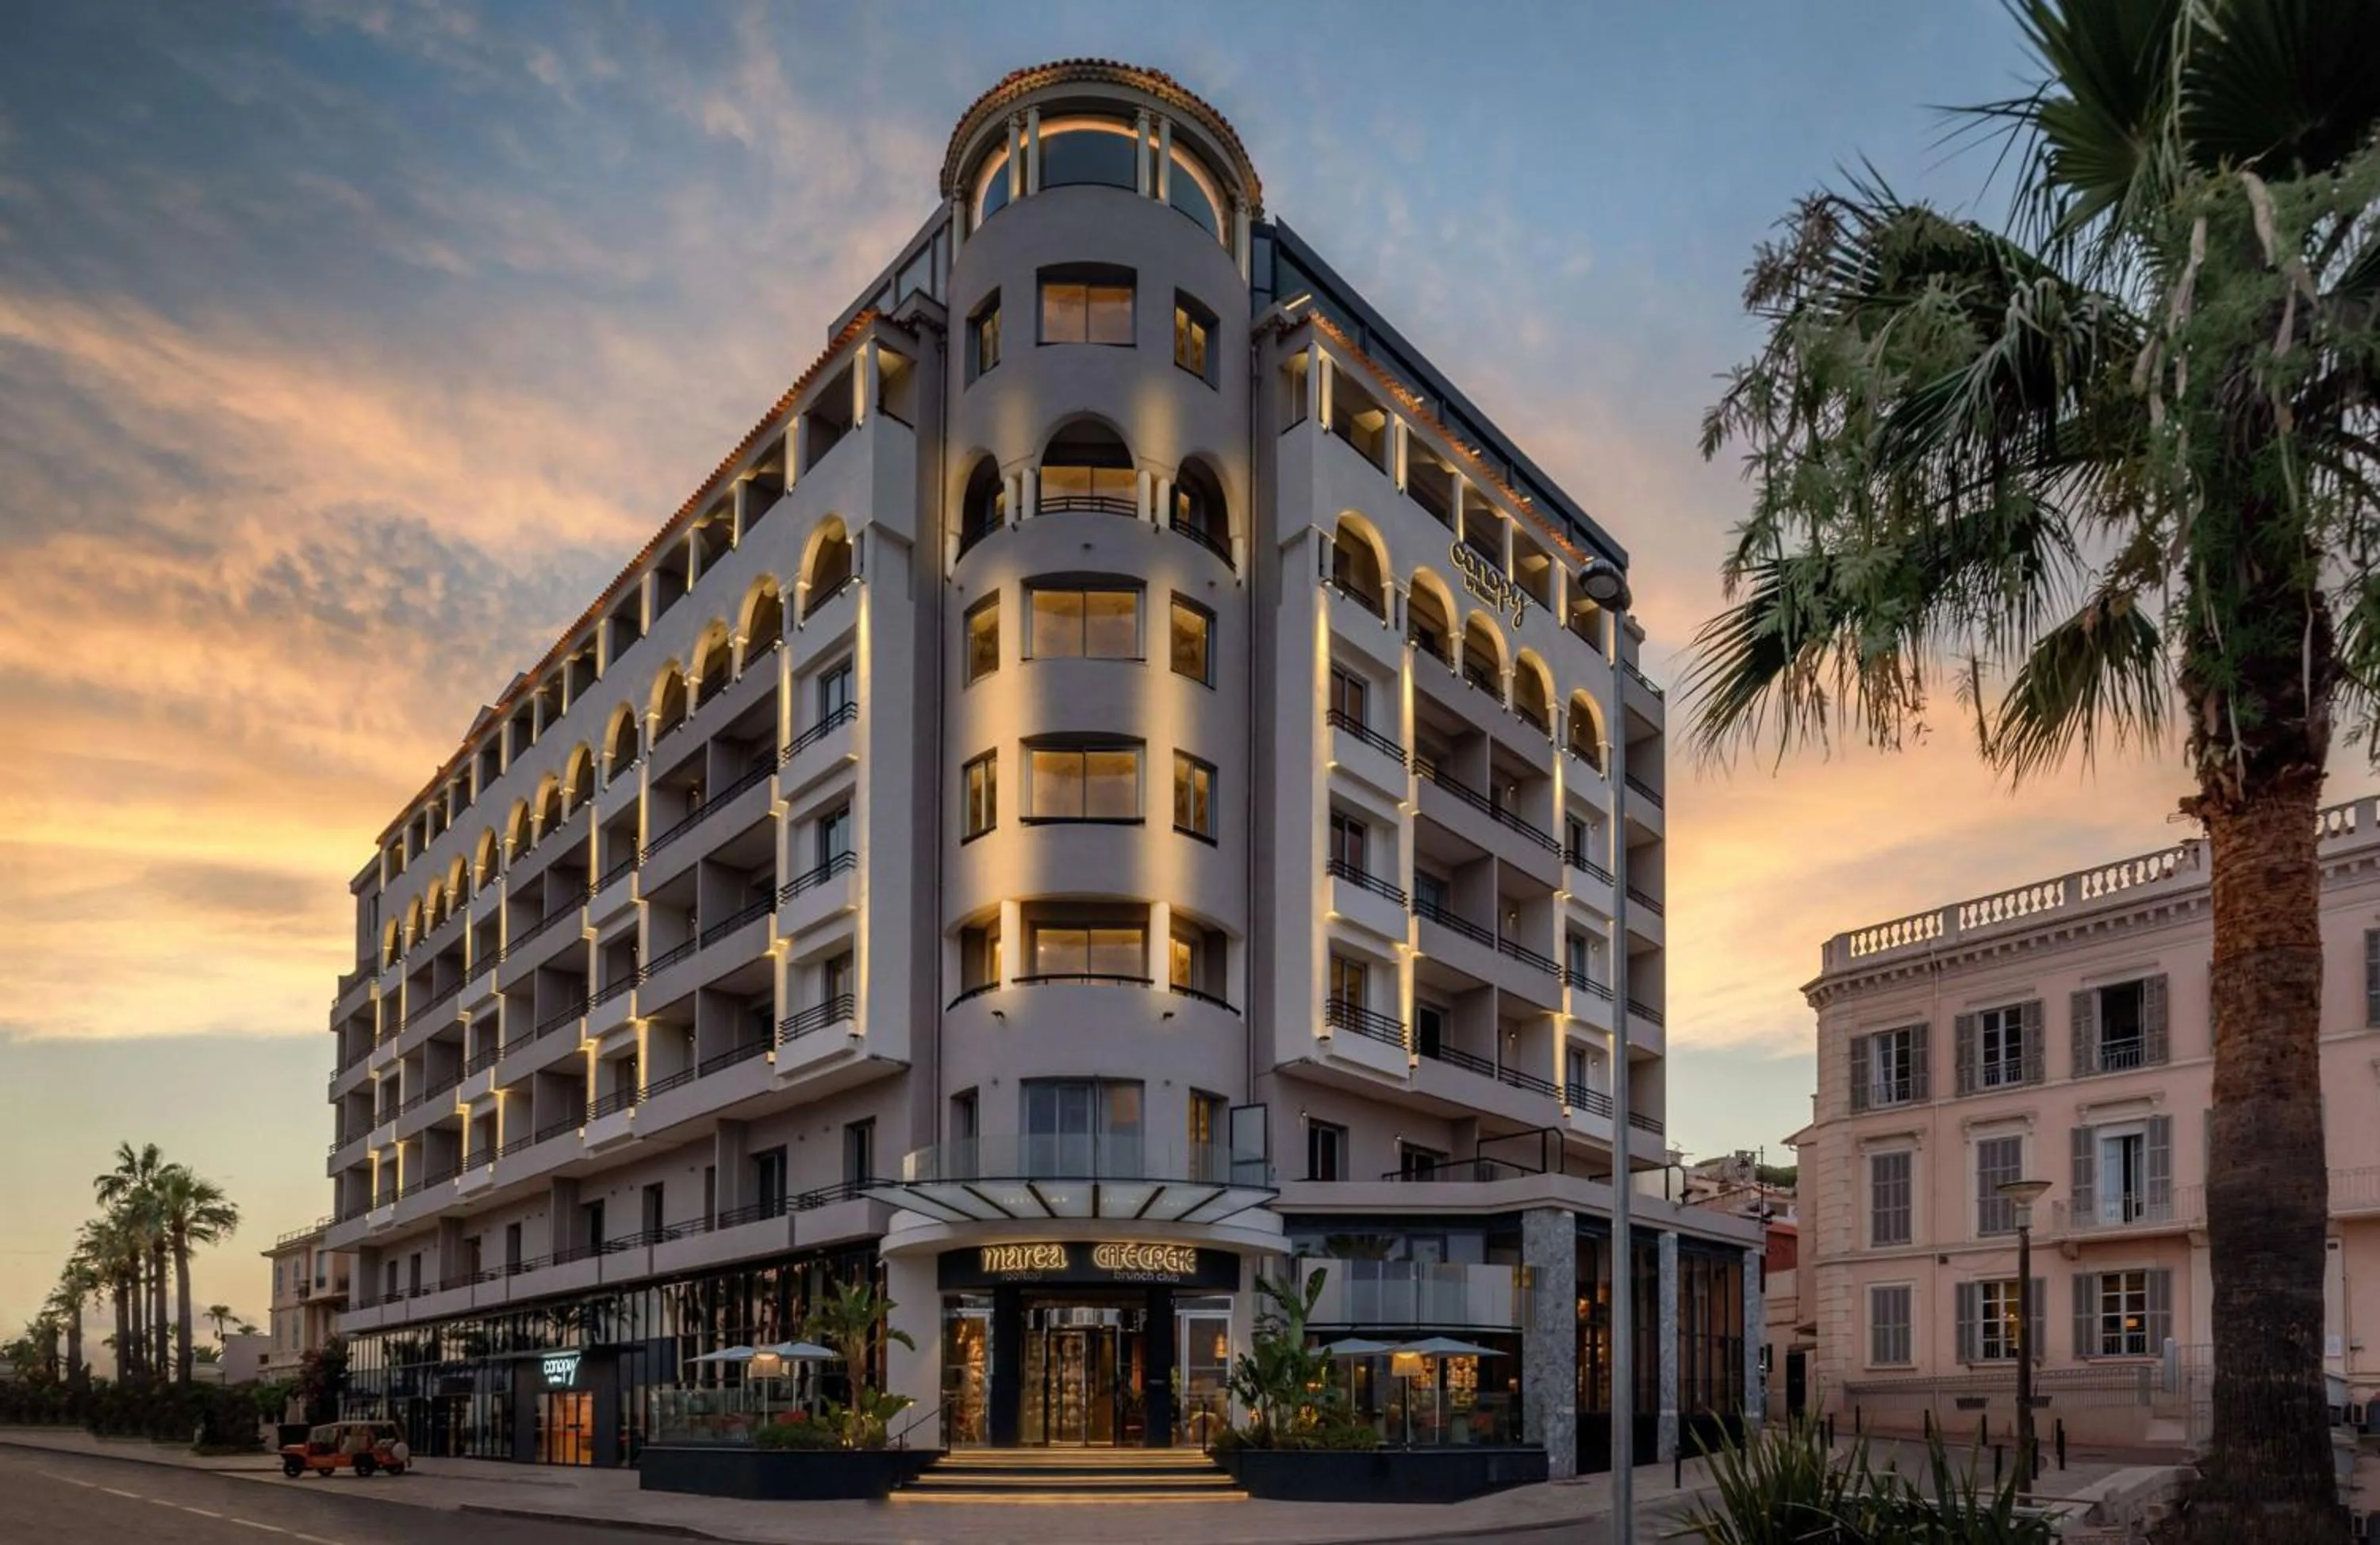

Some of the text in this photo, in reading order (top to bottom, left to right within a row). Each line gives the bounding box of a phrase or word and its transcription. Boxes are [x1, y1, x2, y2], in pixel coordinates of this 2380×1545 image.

[1450, 540, 1534, 631] canopy
[982, 1244, 1068, 1271] marea
[1113, 1268, 1180, 1282] brunch club
[543, 1355, 581, 1386] canopy
